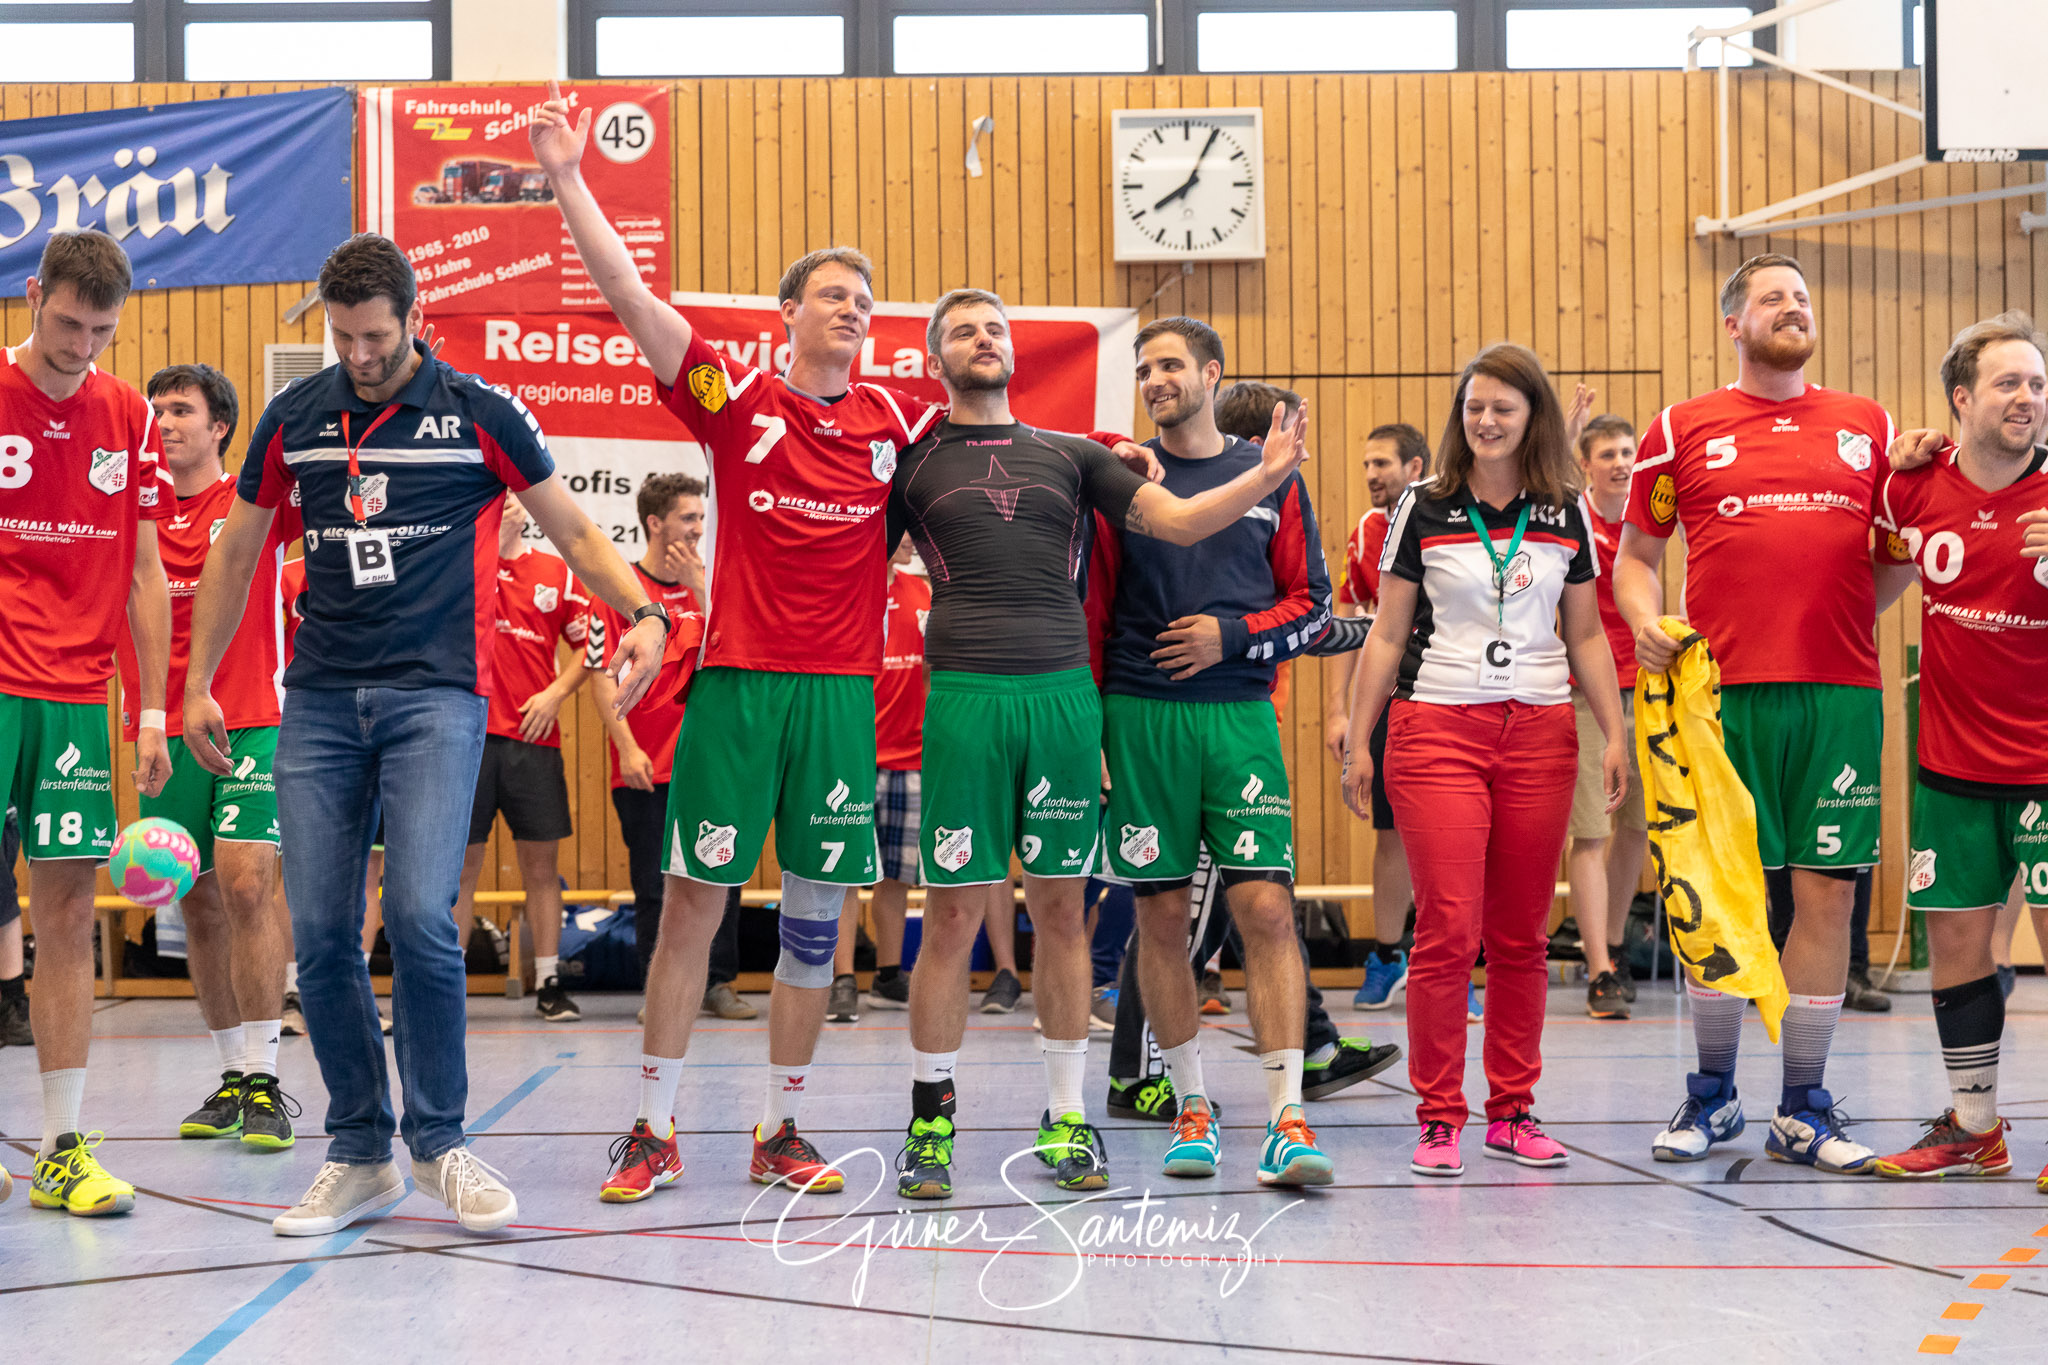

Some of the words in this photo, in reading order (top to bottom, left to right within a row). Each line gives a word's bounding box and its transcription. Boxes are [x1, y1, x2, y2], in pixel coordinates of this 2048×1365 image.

[405, 99, 512, 116] Fahrschule
[484, 90, 579, 141] Schlit
[602, 115, 645, 149] 45
[407, 241, 445, 265] 1965
[452, 225, 490, 249] 2010
[416, 265, 434, 285] 45
[434, 256, 472, 279] Jahre
[420, 274, 496, 305] Fahrschule
[494, 252, 553, 281] Schlicht
[860, 337, 925, 379] La
[516, 381, 614, 406] regionale
[620, 384, 653, 406] DB
[43, 430, 71, 440] erima
[413, 415, 462, 440] AR
[743, 413, 787, 465] 7
[813, 426, 843, 438] erima
[1772, 425, 1800, 433] erima
[966, 437, 1013, 447] hummel
[1705, 434, 1739, 470] 5
[562, 470, 631, 495] ofis
[777, 496, 842, 515] MICHAEL
[846, 505, 884, 517] WÖLF
[1746, 493, 1809, 505] MICHAEL
[1812, 490, 1852, 505] WÖLFL
[0, 518, 53, 532] ICHAEL
[57, 521, 95, 535] WÖLFL
[168, 521, 191, 531] erima
[321, 526, 373, 538] MICH
[612, 525, 640, 544] 21
[1970, 520, 1999, 530] erima
[355, 539, 387, 571] B
[1934, 602, 1982, 620] MICHAEL
[1985, 610, 2029, 626] WÖLFL
[1485, 640, 1512, 668] C
[34, 811, 84, 846] 18
[218, 804, 241, 832] 2
[91, 838, 112, 848] erima
[1021, 834, 1043, 865] 9
[1233, 830, 1260, 861] 4
[1816, 825, 1842, 856] 5
[821, 841, 846, 873] 7
